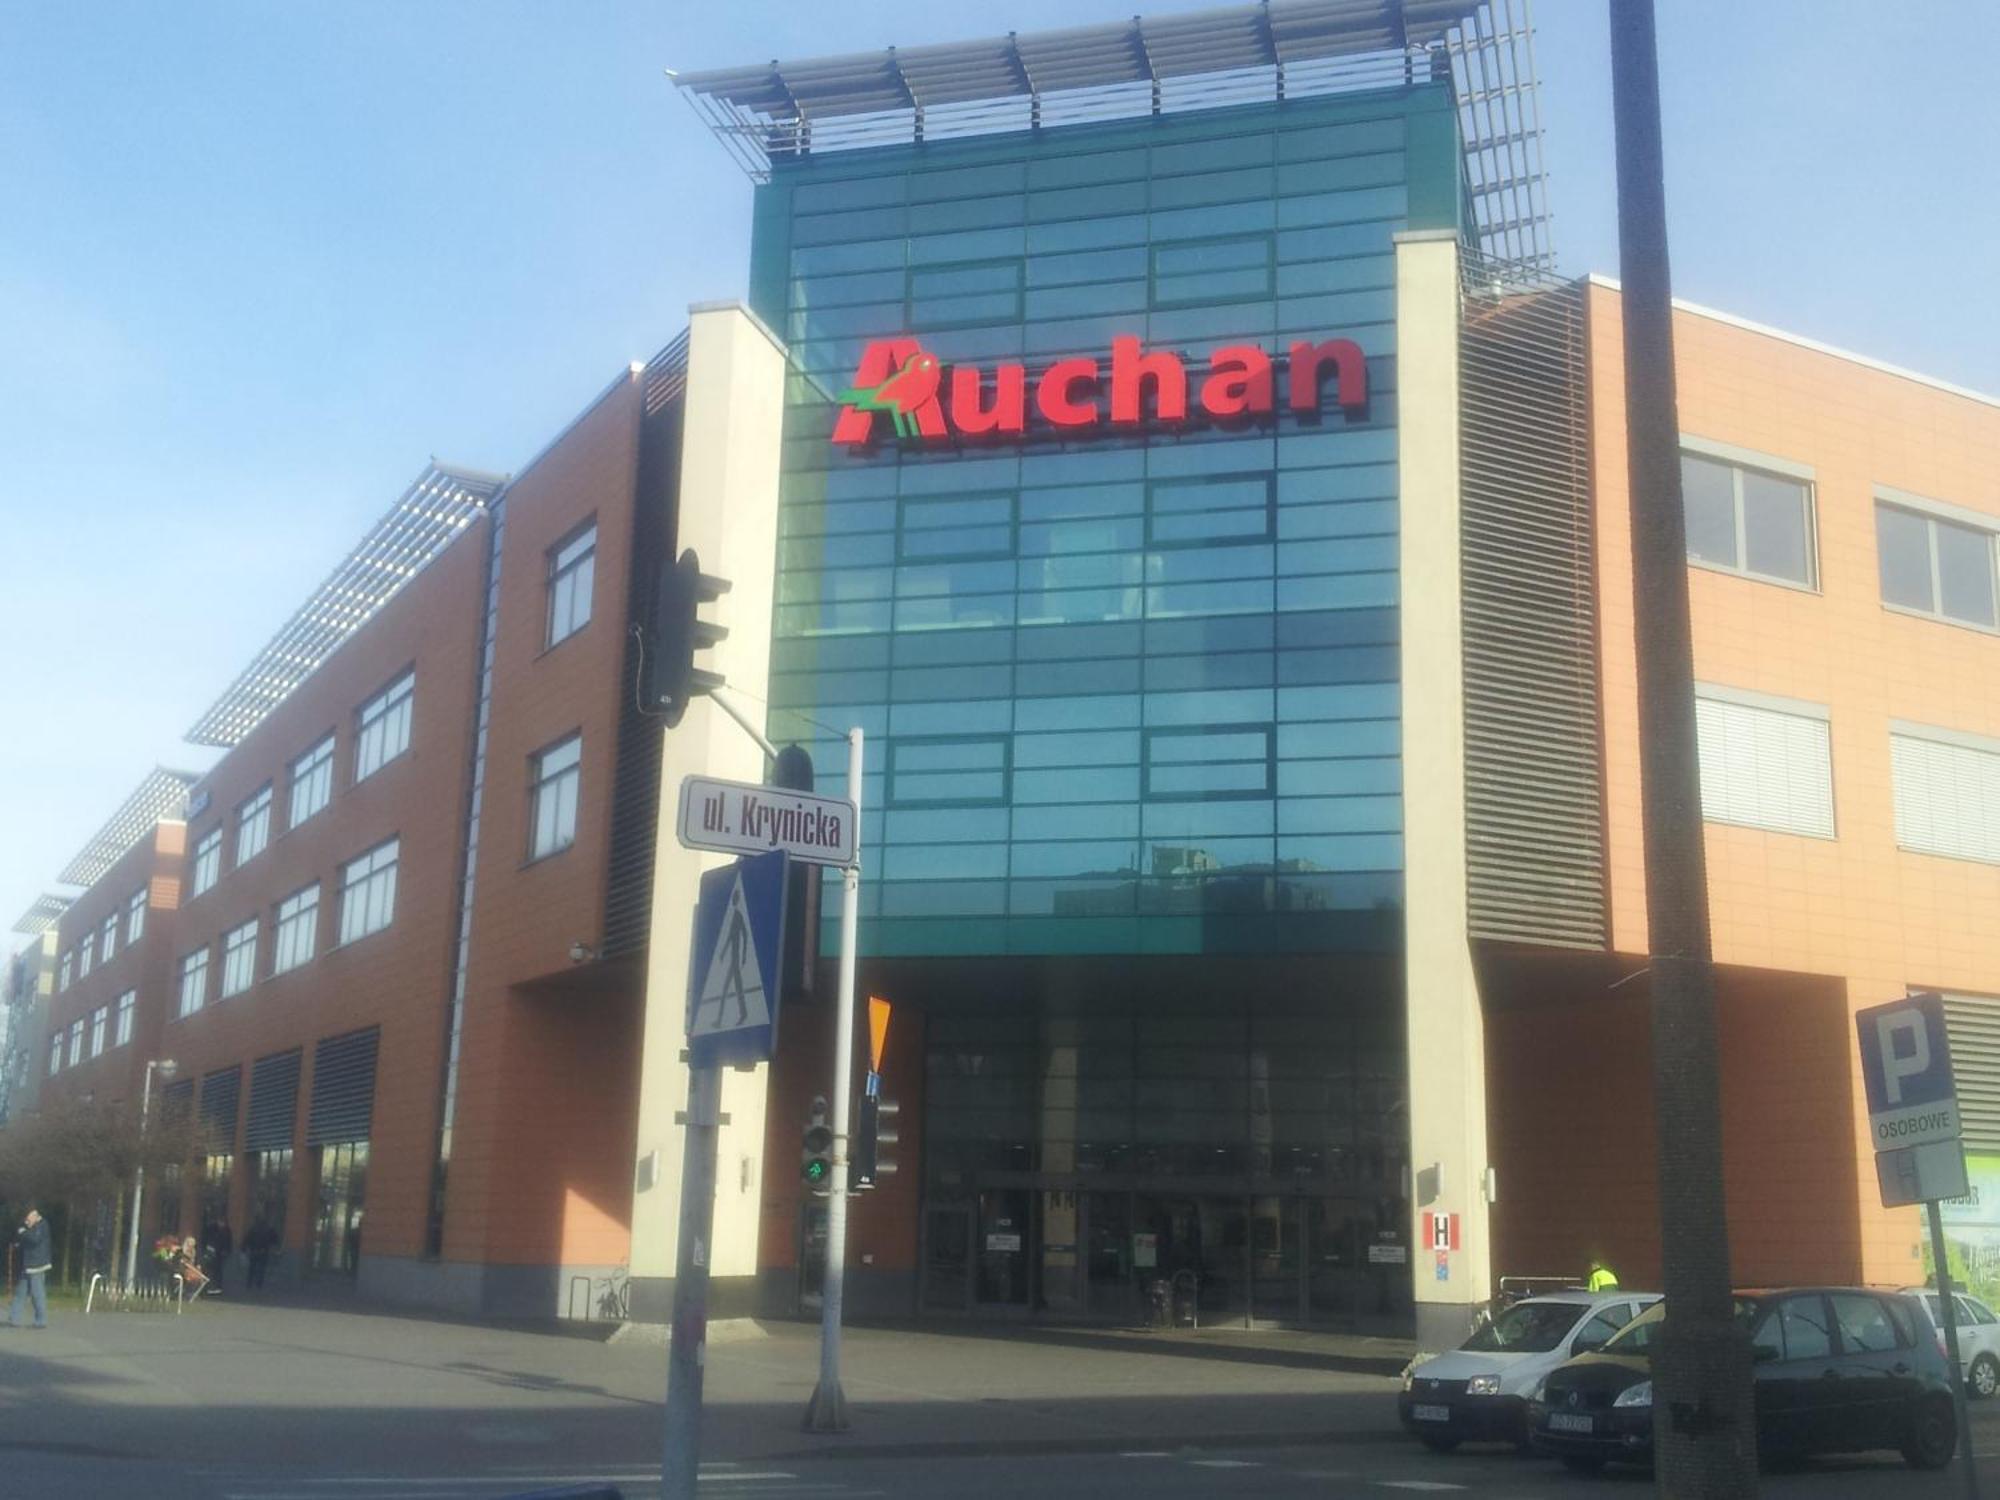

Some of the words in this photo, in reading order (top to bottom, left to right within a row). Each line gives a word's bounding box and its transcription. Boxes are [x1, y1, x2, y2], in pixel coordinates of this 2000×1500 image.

[831, 333, 1368, 445] Auchan
[703, 791, 731, 833] ul.
[740, 795, 842, 848] Krynicka
[1876, 1008, 1931, 1103] P
[1878, 1111, 1950, 1139] OSOBOWE
[1434, 1216, 1449, 1247] H
